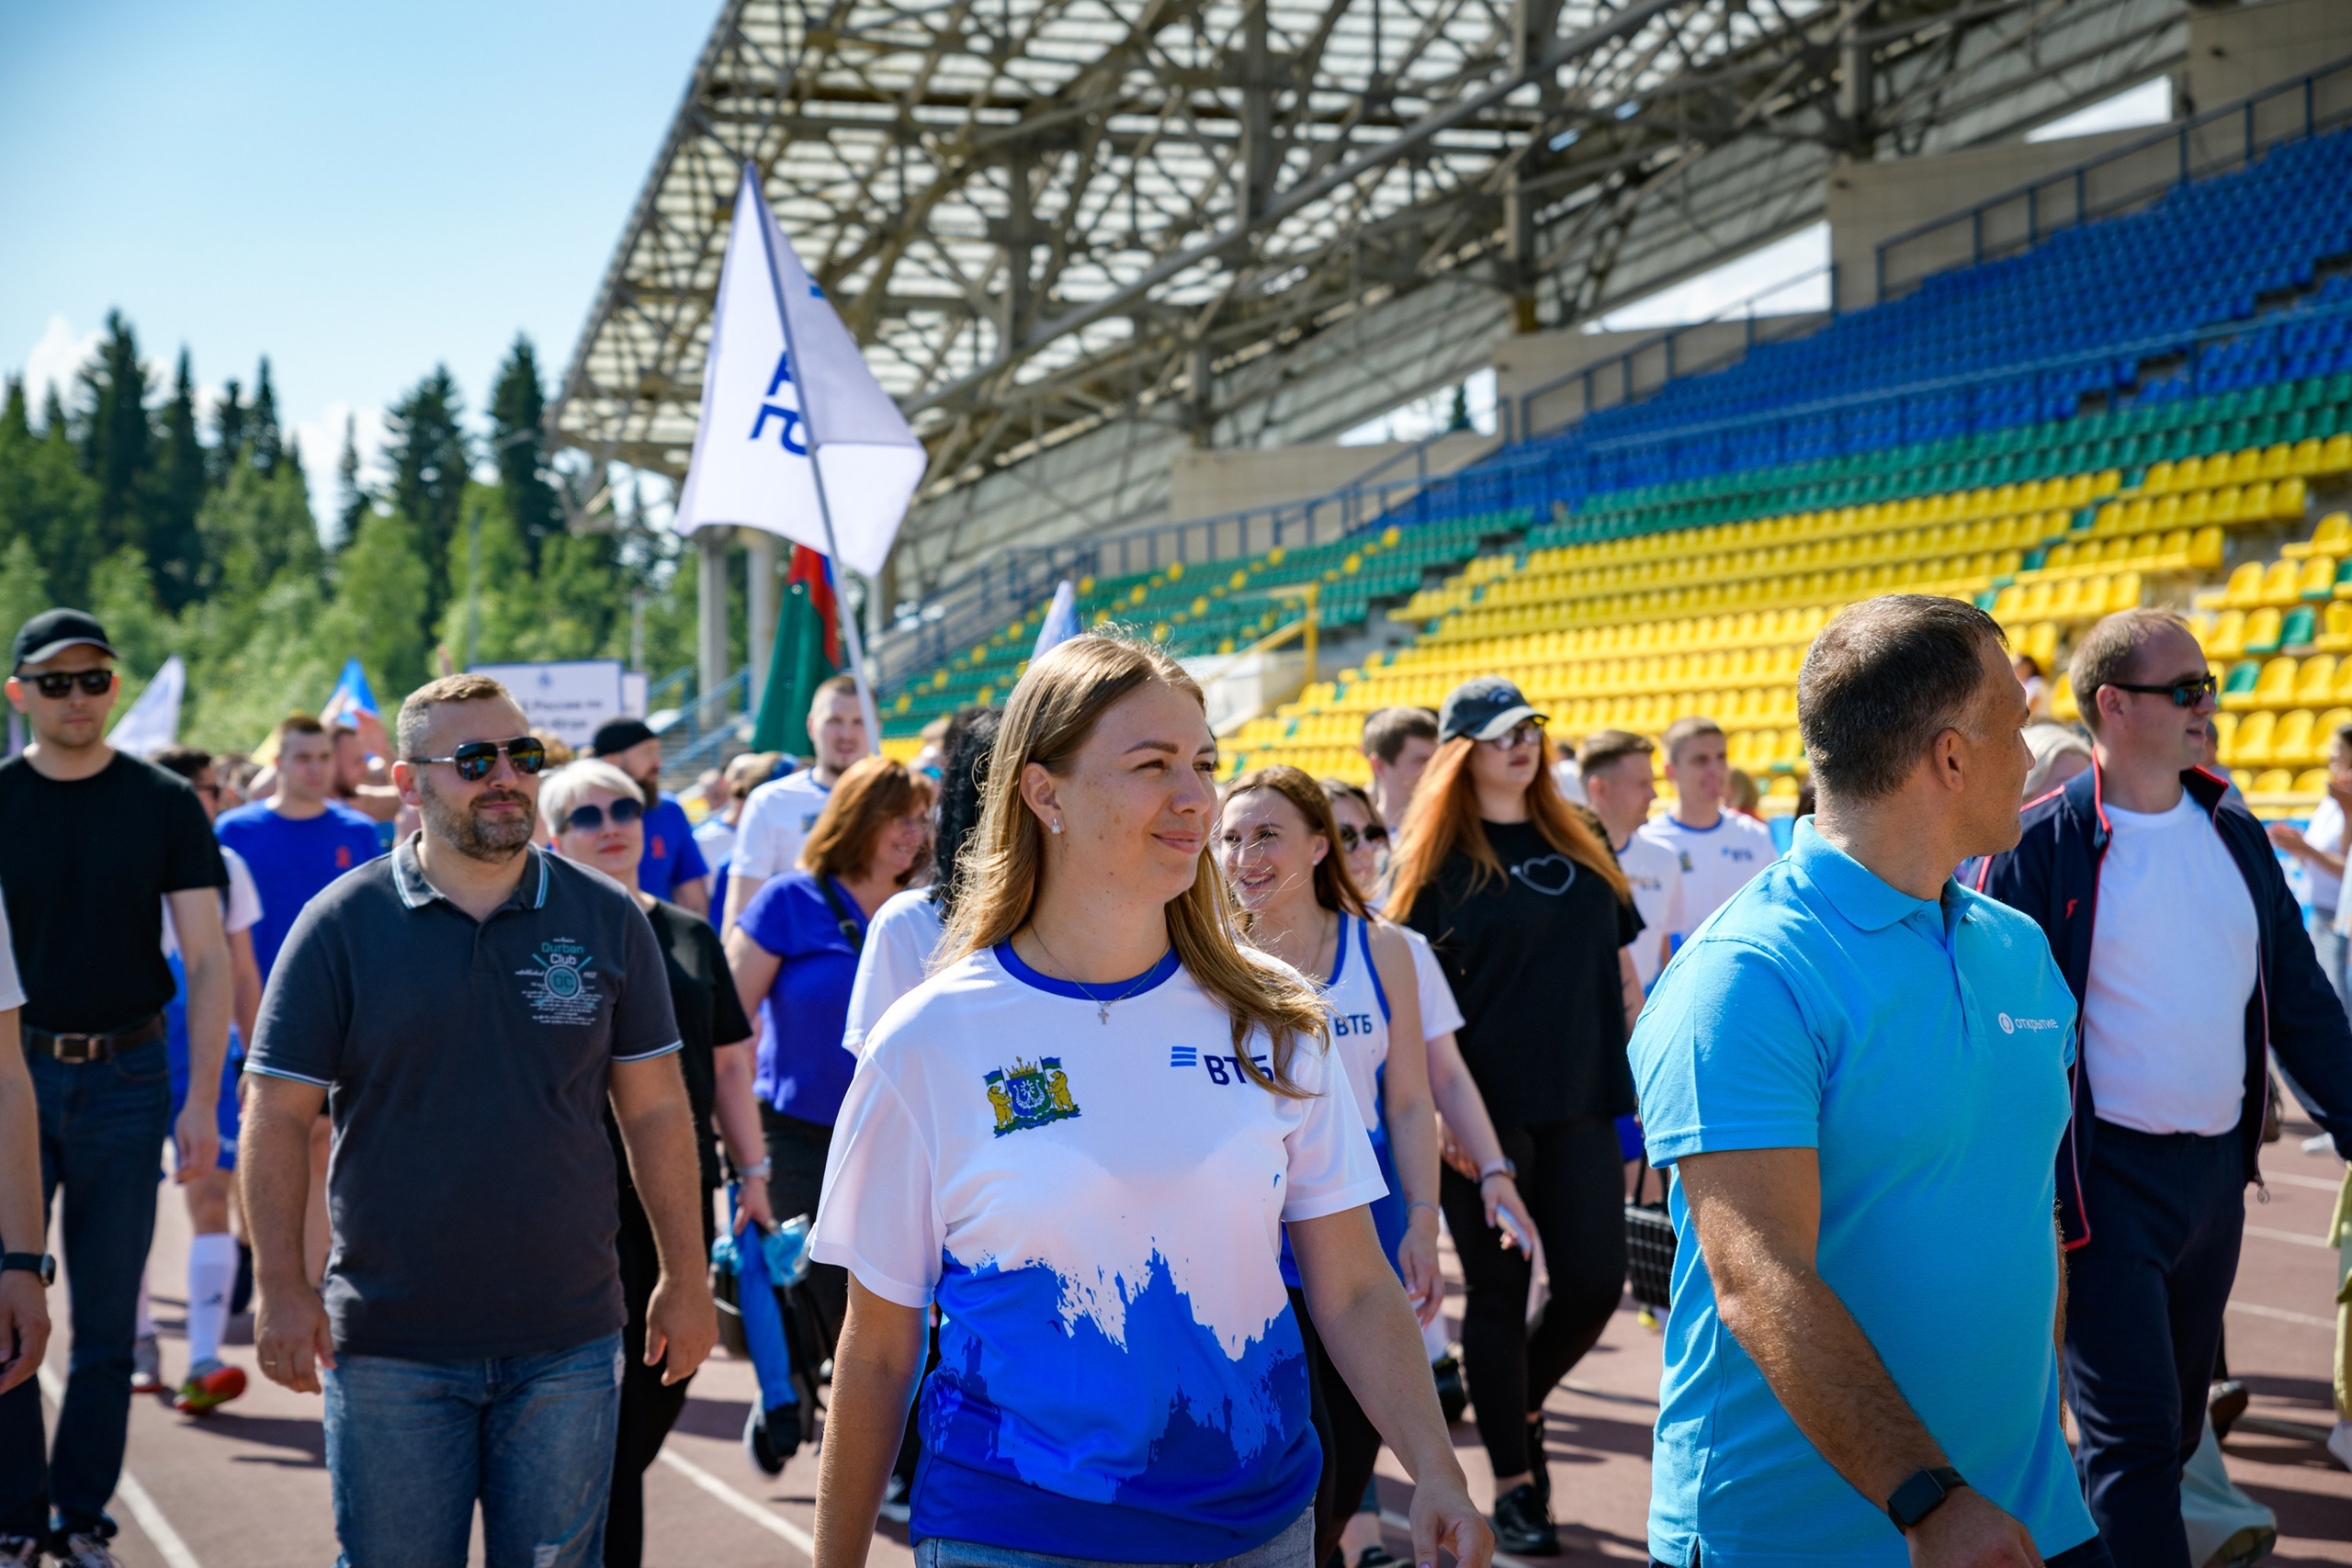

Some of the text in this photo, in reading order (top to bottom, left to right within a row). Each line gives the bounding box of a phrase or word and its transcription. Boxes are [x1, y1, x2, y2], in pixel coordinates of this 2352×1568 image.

[541, 942, 584, 954] Durban
[549, 953, 577, 965] Club
[1334, 1014, 1373, 1037] ВТБ
[2014, 1018, 2059, 1033] открытие
